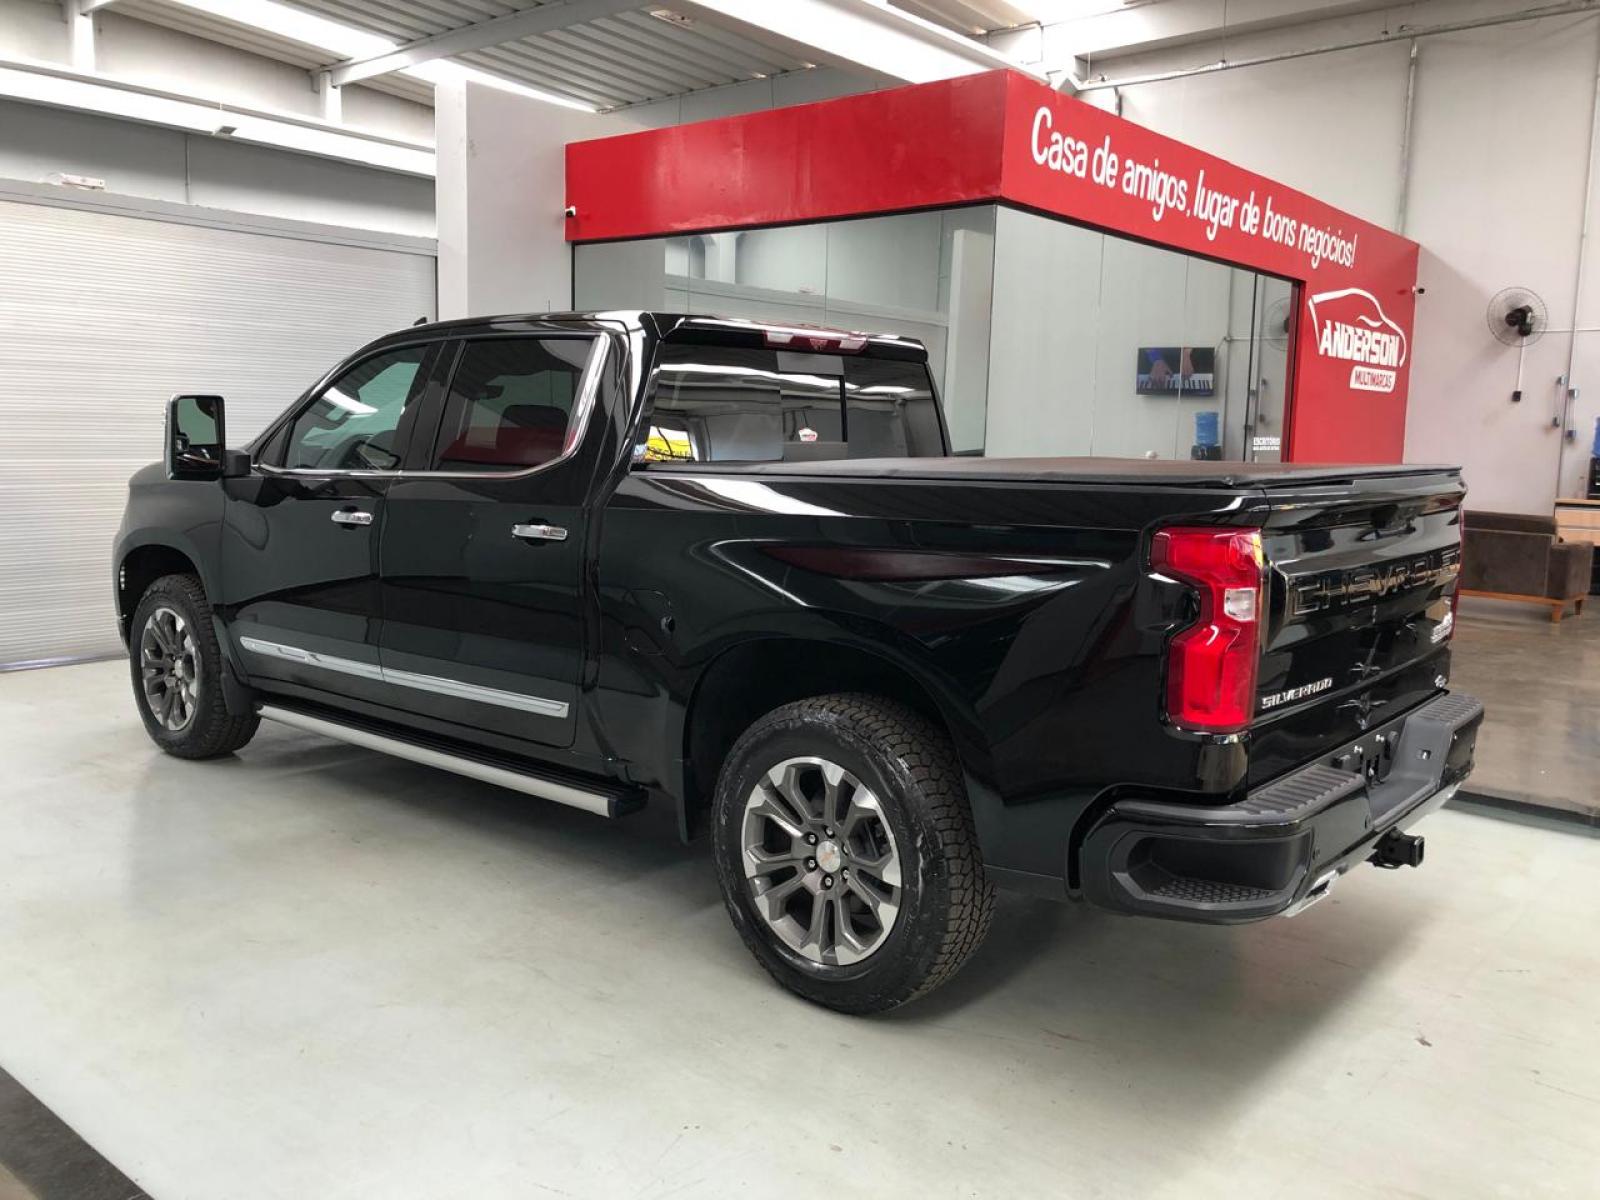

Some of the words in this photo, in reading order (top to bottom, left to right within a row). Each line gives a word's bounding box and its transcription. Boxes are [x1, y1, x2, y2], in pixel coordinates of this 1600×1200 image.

[1031, 106, 1088, 179] Casa
[1092, 135, 1119, 188] de
[1122, 158, 1191, 222] amigos,
[1193, 169, 1240, 241] lugar
[1240, 190, 1261, 236] de
[1262, 196, 1298, 247] bons
[1298, 223, 1358, 270] negócios!
[1319, 319, 1400, 368] ANDERSON
[1353, 369, 1393, 389] MULTIMARCAS
